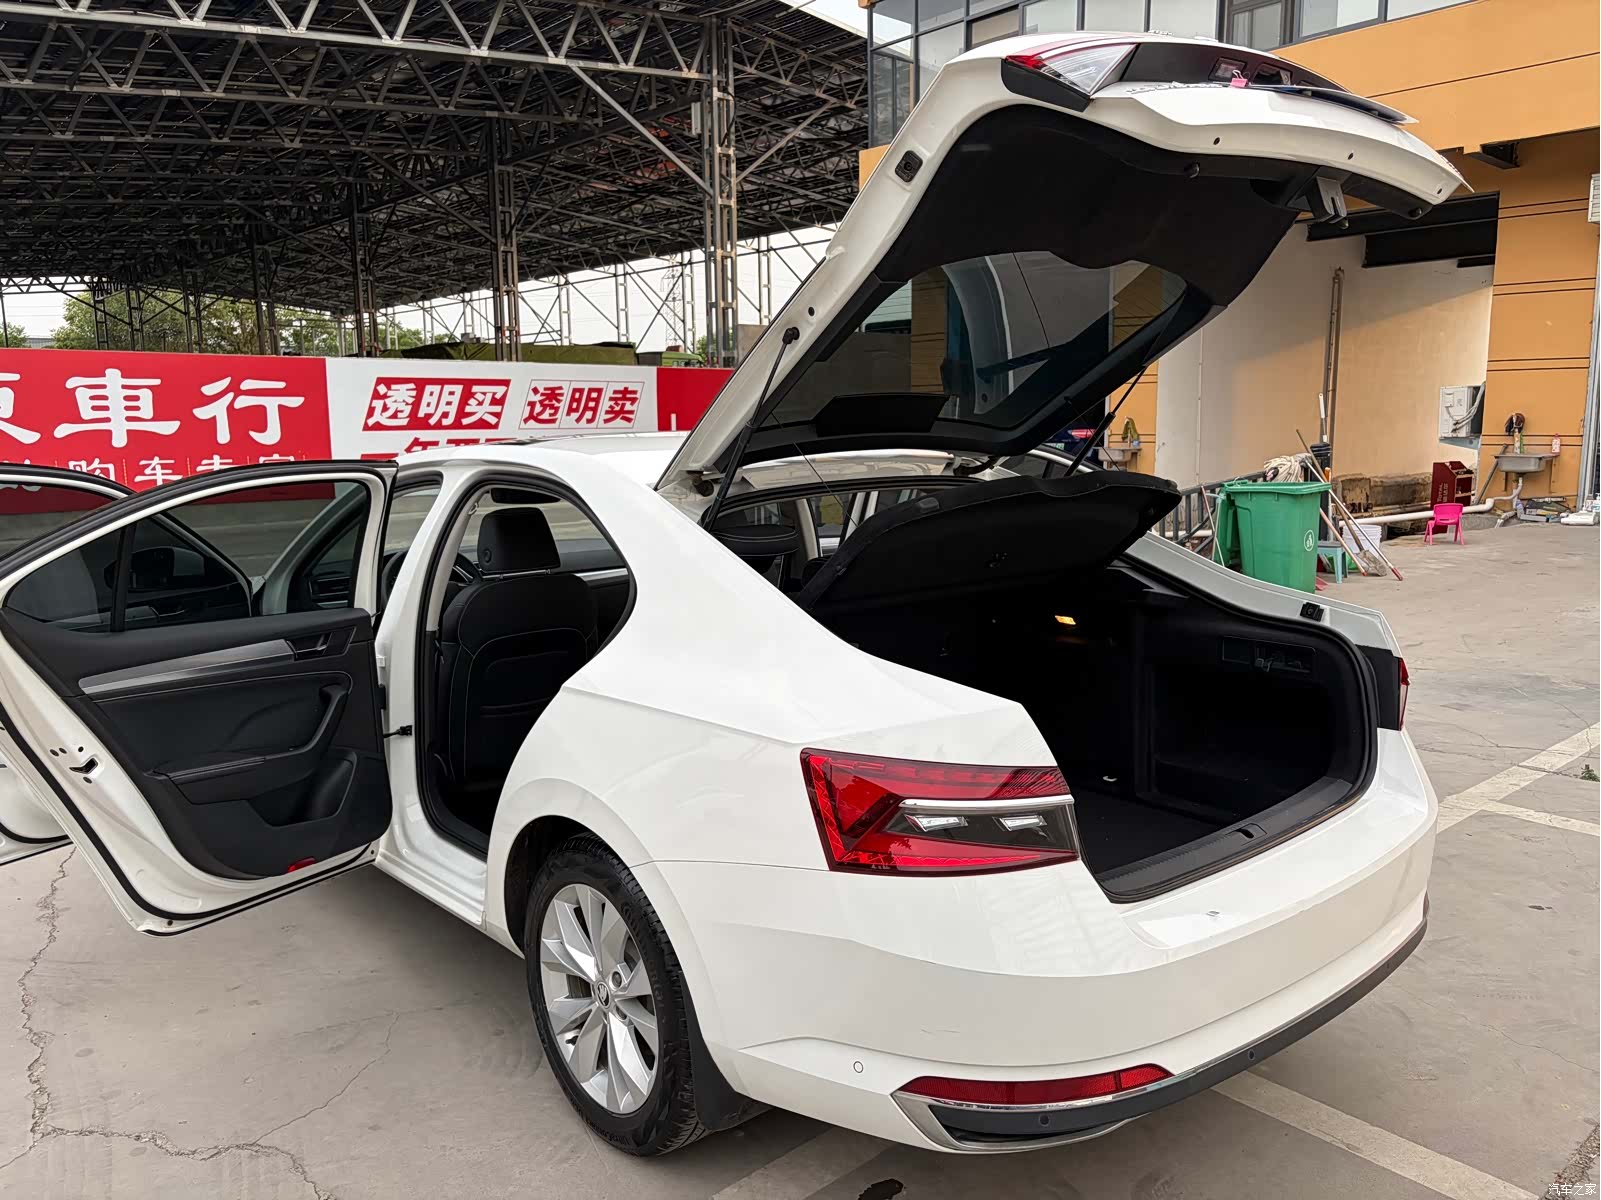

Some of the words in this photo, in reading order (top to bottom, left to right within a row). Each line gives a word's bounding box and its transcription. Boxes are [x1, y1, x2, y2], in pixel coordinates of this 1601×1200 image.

[367, 383, 509, 428] 透明买
[522, 386, 641, 426] 透明卖
